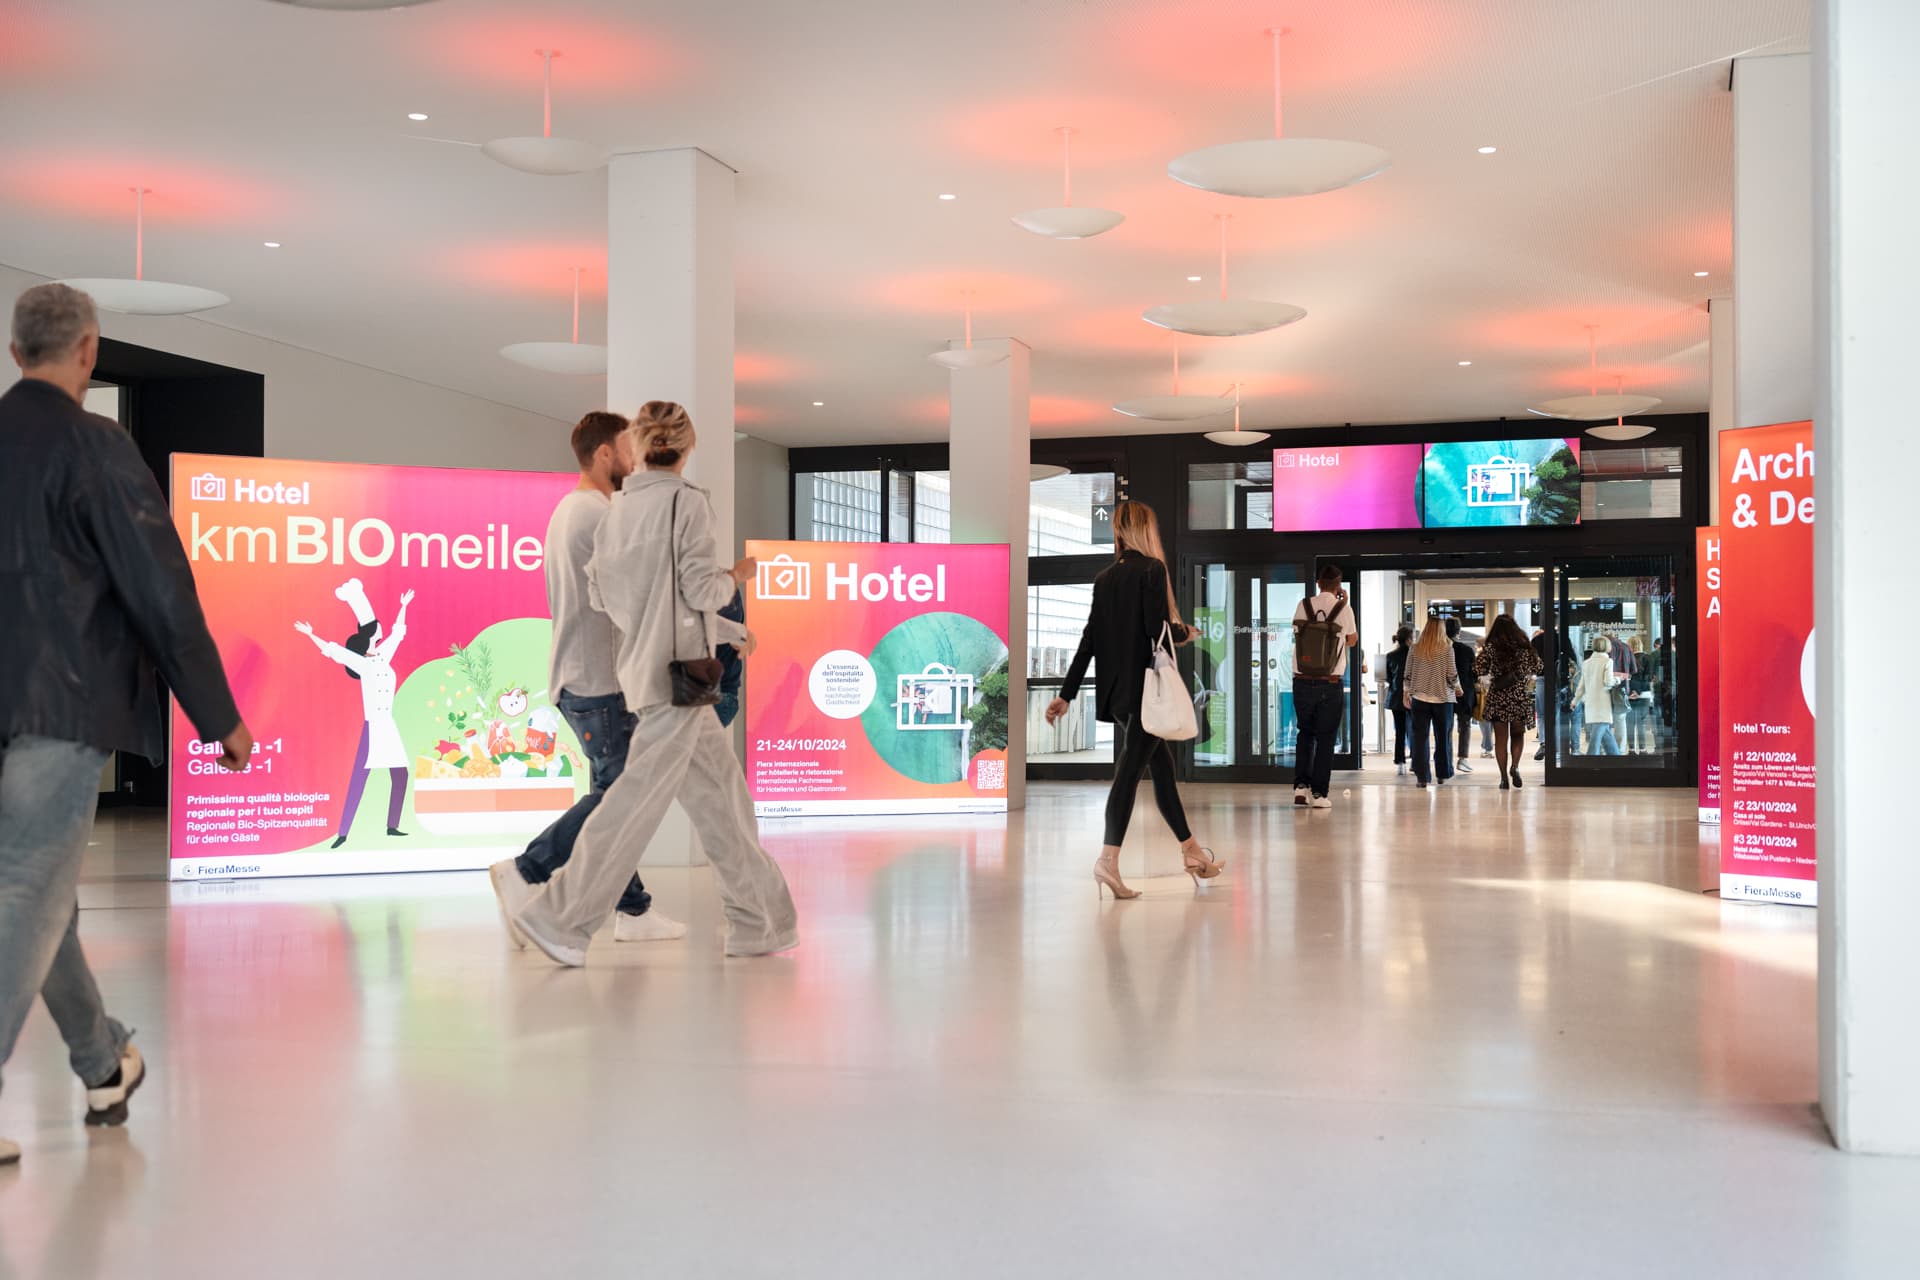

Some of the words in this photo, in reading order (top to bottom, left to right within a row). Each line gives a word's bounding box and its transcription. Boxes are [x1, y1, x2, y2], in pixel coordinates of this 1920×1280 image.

[1299, 453, 1339, 467] Hotel
[1731, 442, 1814, 484] Arch
[234, 478, 310, 505] Hotel
[1732, 493, 1759, 528] &
[1770, 490, 1815, 525] De
[826, 562, 946, 602] Hotel
[1733, 723, 1758, 733] Hotel
[1760, 723, 1791, 734] Tours:
[265, 738, 282, 754] -1
[756, 739, 847, 751] 21-24/10/2024
[1733, 752, 1743, 760] #1
[1746, 752, 1797, 762] 22/10/2024
[256, 758, 272, 773] -1
[187, 795, 245, 805] Primissima
[247, 793, 281, 804] qualità
[283, 792, 330, 803] biologica
[187, 808, 235, 819] regionale
[238, 808, 255, 818] per
[263, 806, 283, 816] tuoi
[285, 805, 313, 816] ospiti
[1733, 800, 1744, 810] #2
[1746, 801, 1797, 813] 23/10/2024
[187, 821, 235, 832] Regionale
[238, 818, 327, 830] Bio-Spitzenqualität
[186, 835, 200, 844] für
[202, 834, 229, 844] deine
[231, 833, 260, 843] Gäste
[1733, 834, 1744, 844] #3
[1746, 835, 1797, 847] 23/10/2024
[198, 865, 260, 875] FieraMesse
[1744, 885, 1802, 899] FieraMesse
